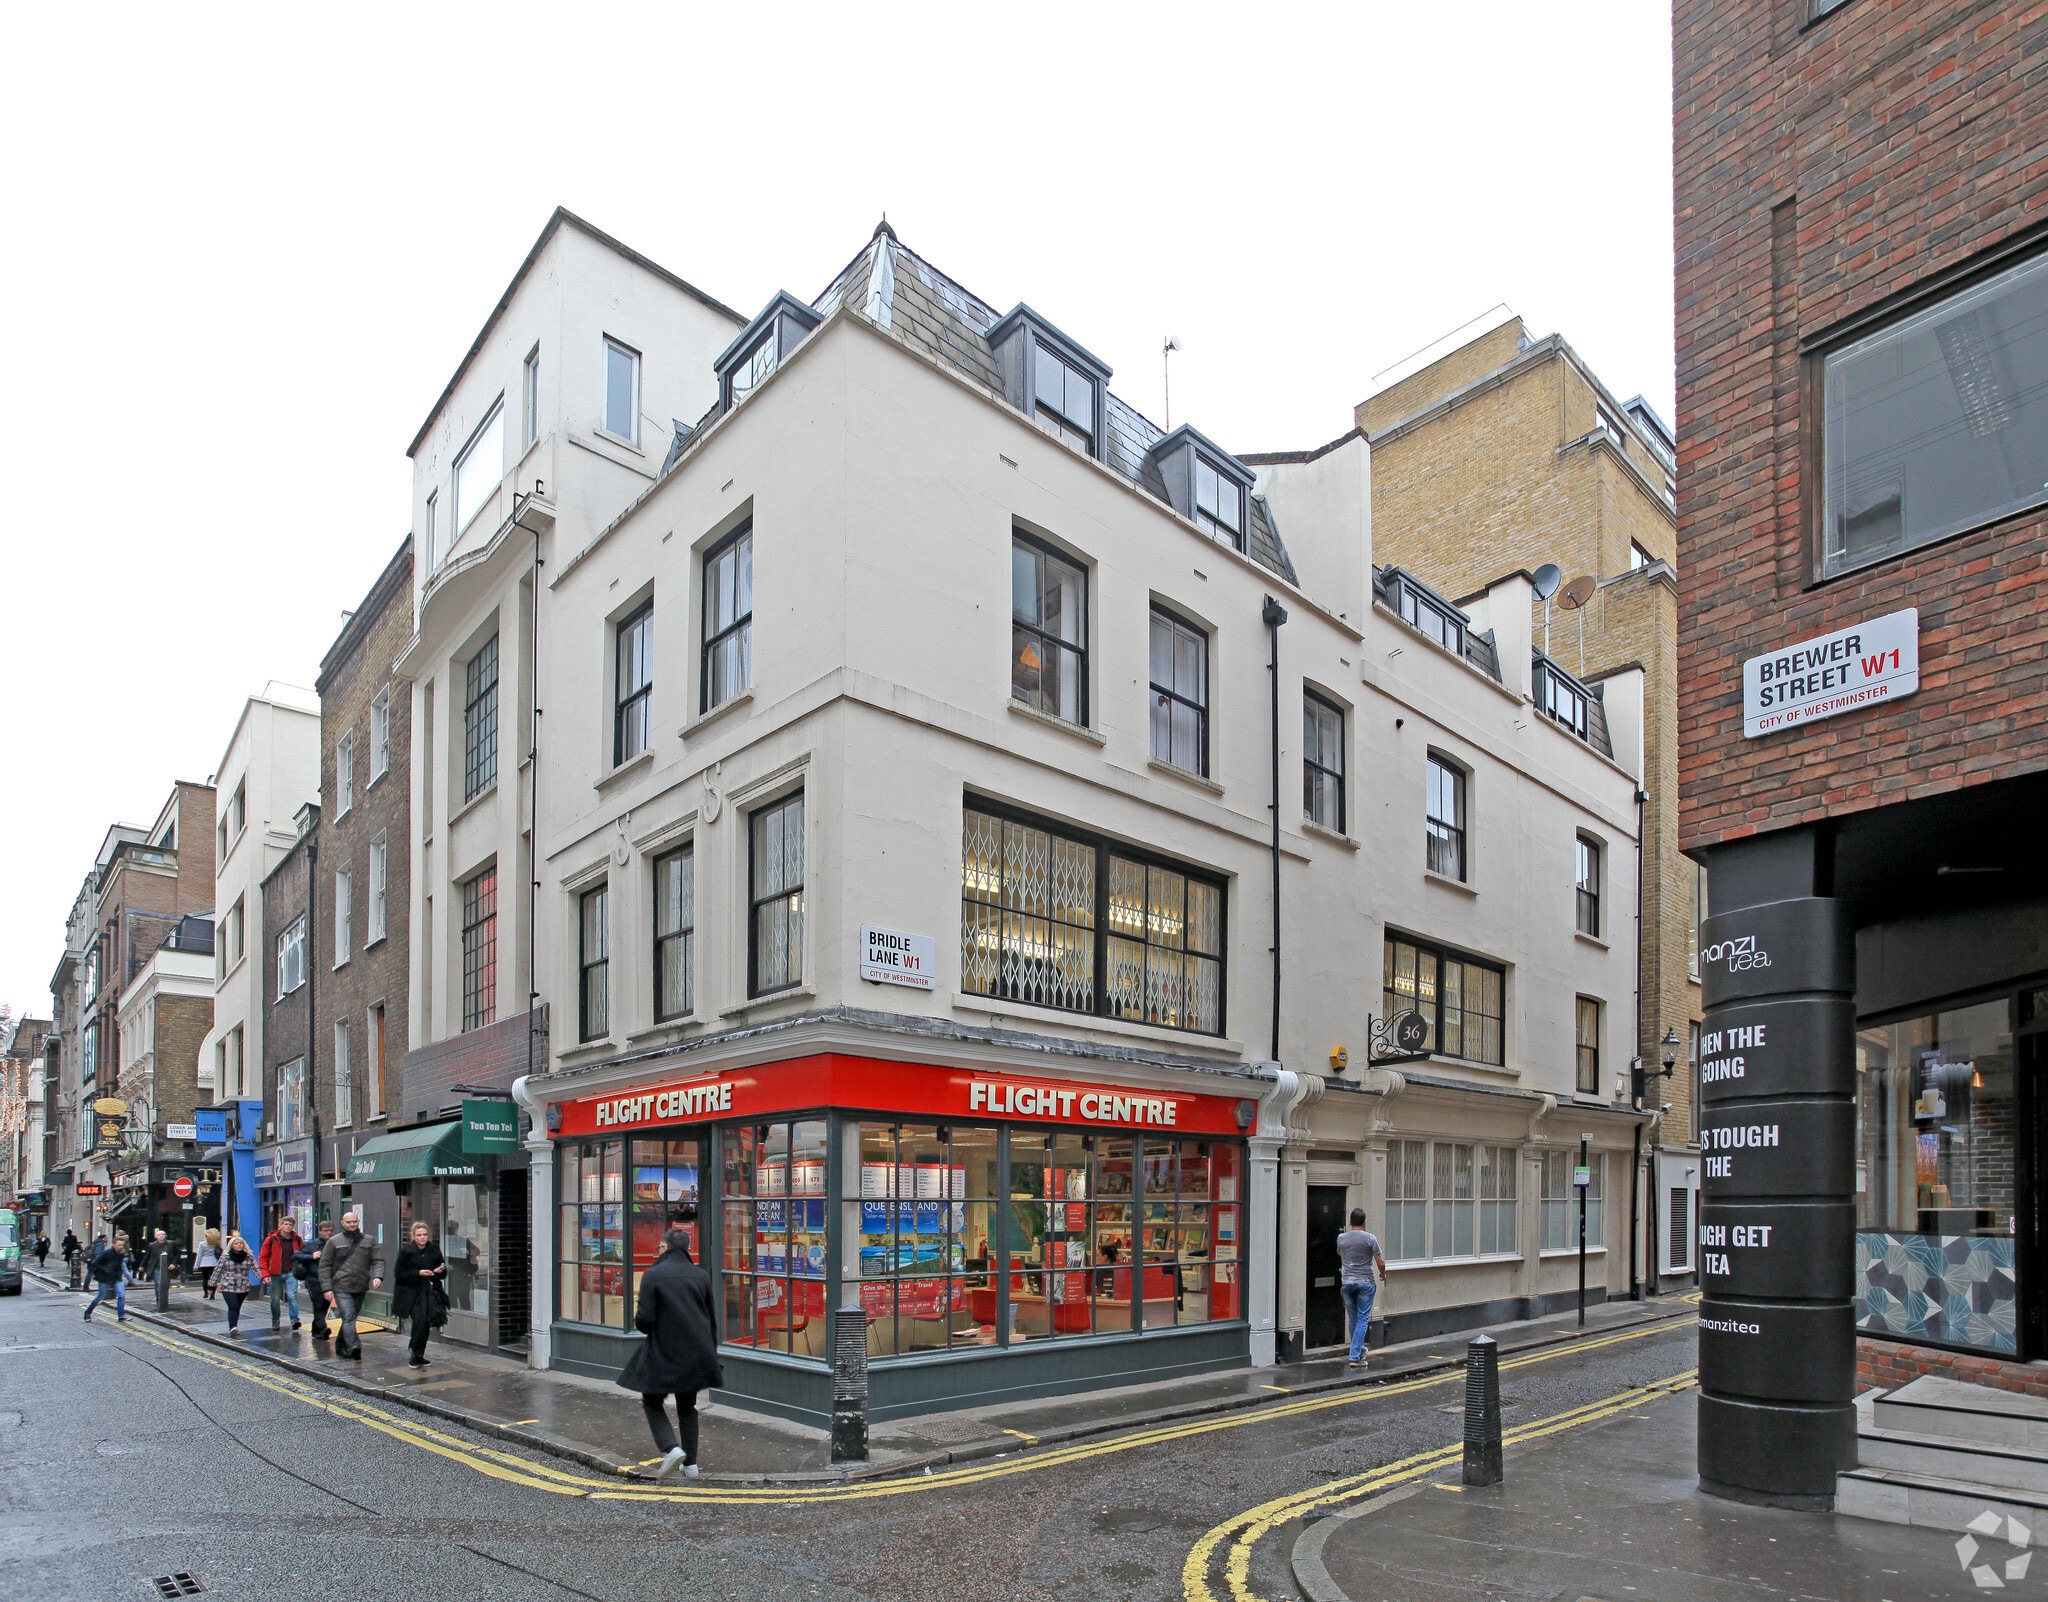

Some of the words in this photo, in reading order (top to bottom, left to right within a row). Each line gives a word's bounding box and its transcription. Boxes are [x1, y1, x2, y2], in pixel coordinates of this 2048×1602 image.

[1760, 635, 1861, 683] BREWER
[1760, 663, 1851, 708] STREET
[1861, 648, 1901, 677] W1
[1759, 714, 1783, 730] CITY
[1786, 710, 1800, 722] OF
[1804, 685, 1888, 717] WESTMINSTER
[870, 931, 911, 951] BRIDLE
[869, 948, 899, 966] LANE
[903, 954, 920, 970] W1
[1726, 951, 1772, 973] tea
[870, 970, 882, 978] CITY
[892, 974, 929, 986] WESTMINSTER
[1403, 1024, 1420, 1041] 36
[1701, 1031, 1722, 1057] HEN
[1727, 1024, 1766, 1050] THE
[1702, 1056, 1745, 1084] GOING
[596, 1095, 654, 1127] FLIGHT
[655, 1082, 733, 1119] CENTRE
[970, 1082, 1077, 1117] FLIGHT
[1079, 1093, 1177, 1126] CENTRE
[470, 1121, 485, 1131] Ten
[485, 1122, 500, 1131] Ten
[500, 1123, 512, 1132] Tei
[1700, 1129, 1709, 1151] TS
[1712, 1125, 1779, 1149] TOUGH
[285, 1160, 304, 1173] HARDWARE
[354, 1161, 363, 1174] Ten
[362, 1161, 370, 1174] Ten
[434, 1166, 448, 1175] Ten
[449, 1166, 462, 1175] Ten
[463, 1166, 475, 1174] Tei
[1706, 1156, 1732, 1177] THE
[757, 1201, 780, 1210] NDIAN
[864, 1202, 938, 1212] QUEENSLAND
[1732, 1225, 1773, 1248] GET
[1705, 1253, 1731, 1276] TEA
